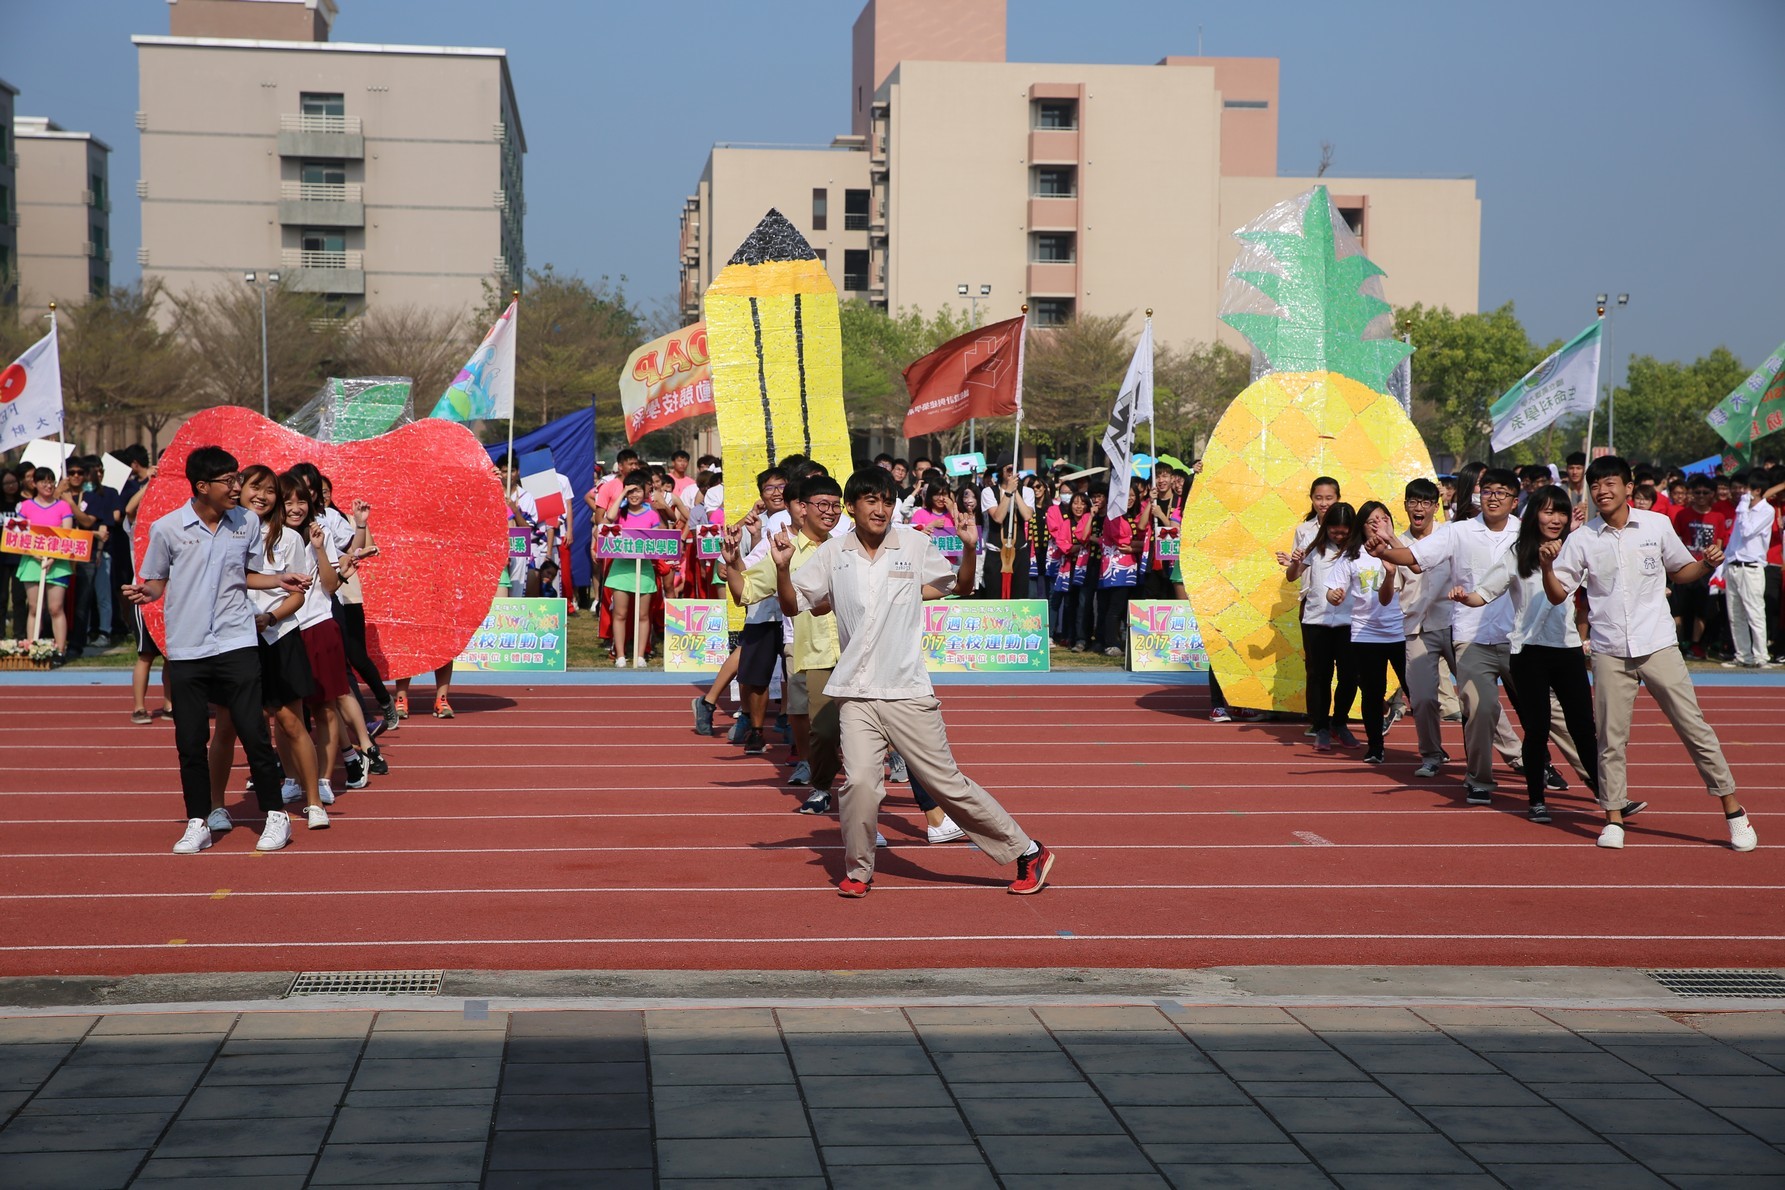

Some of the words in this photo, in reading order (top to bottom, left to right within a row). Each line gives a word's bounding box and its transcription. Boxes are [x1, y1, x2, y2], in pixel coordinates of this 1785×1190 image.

[5, 531, 88, 556] 財經法律學系
[600, 537, 678, 555] 人文社會科學院
